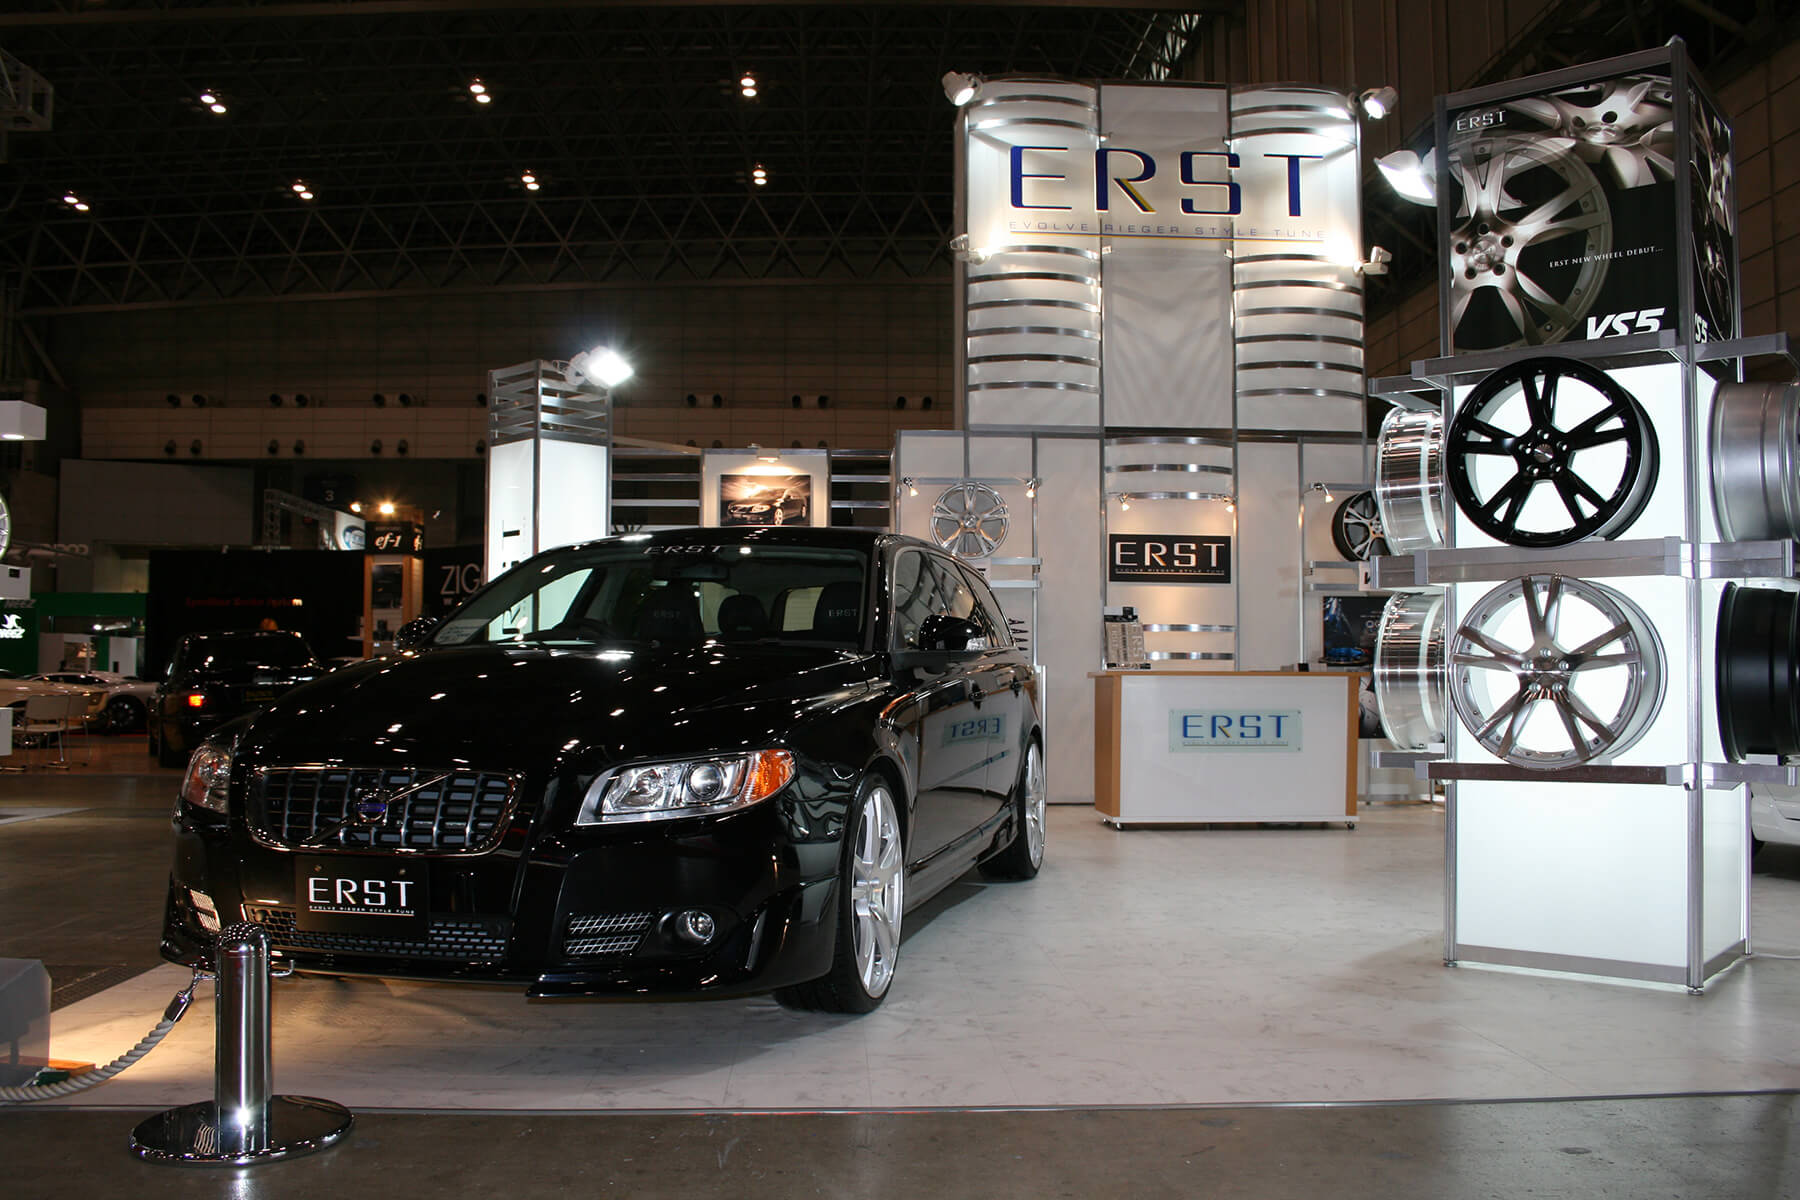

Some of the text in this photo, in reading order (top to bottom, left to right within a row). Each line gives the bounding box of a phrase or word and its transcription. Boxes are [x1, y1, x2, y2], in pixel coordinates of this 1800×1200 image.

[1456, 110, 1507, 131] ERST
[1010, 145, 1324, 217] ERST
[1009, 221, 1327, 238] EVOLVE RIEGER STYLE TUNE
[1549, 259, 1569, 268] ERST
[1571, 256, 1592, 265] NEW
[1593, 251, 1623, 262] WHEEL
[1586, 307, 1666, 341] VS5
[1115, 541, 1225, 568] ERST
[1182, 714, 1289, 739] ERST
[308, 877, 415, 907] ERST
